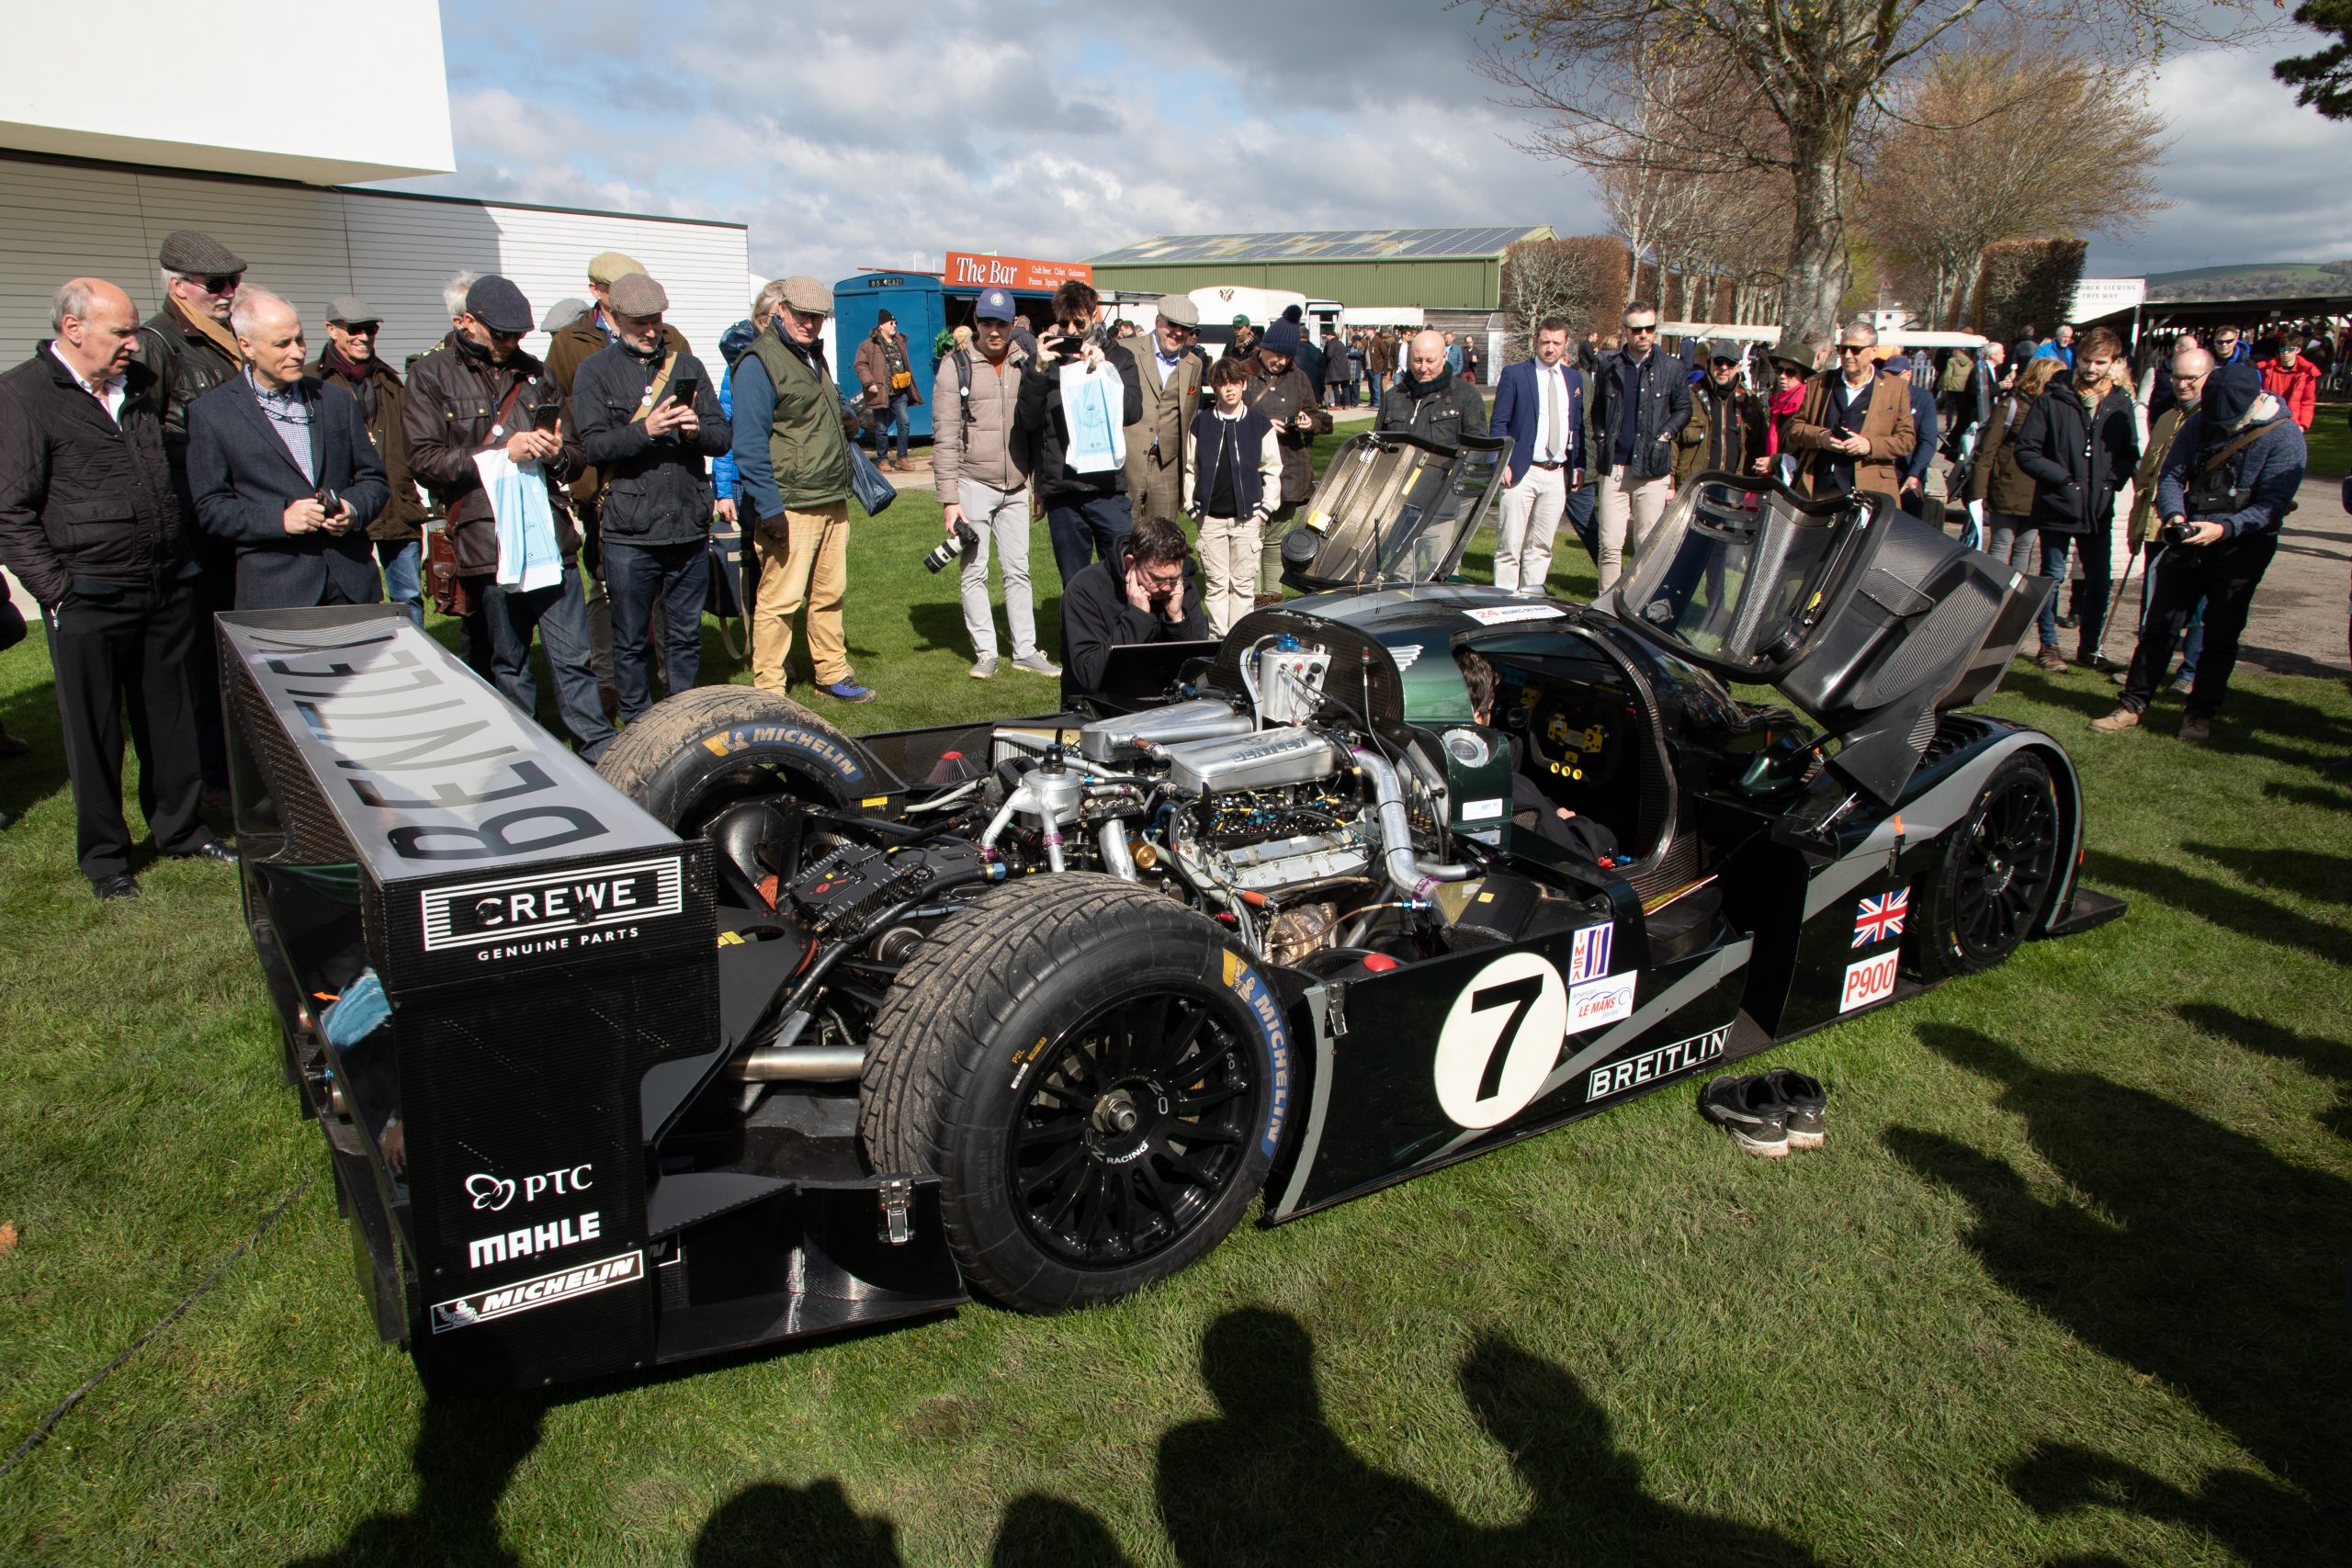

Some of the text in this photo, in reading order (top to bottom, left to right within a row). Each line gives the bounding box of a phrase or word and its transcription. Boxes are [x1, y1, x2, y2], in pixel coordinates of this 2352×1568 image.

[956, 257, 1018, 285] The Bar
[1031, 265, 1042, 275] Craft
[1042, 266, 1052, 275] Beer
[1054, 268, 1066, 276] Cider
[1476, 609, 1499, 619] 24
[248, 634, 611, 861] BENTLEY
[753, 728, 856, 775] MICHELIN
[1230, 738, 1308, 762] BENTLEY
[475, 878, 637, 927] CREWE
[477, 927, 639, 962] GENUINE PARTS
[1572, 932, 1586, 983] IMSA
[1844, 958, 1895, 1004] P900
[1578, 997, 1617, 1018] LE MANS
[1012, 1049, 1025, 1064] P2L
[1472, 973, 1544, 1103] 7
[1254, 993, 1287, 1145] MICHELIN
[1590, 1028, 1728, 1099] BREITLIN
[1106, 1142, 1149, 1165] RACING
[523, 1163, 594, 1202] PTC
[469, 1211, 601, 1269] MAHLE
[481, 1257, 635, 1314] MICHELIN
